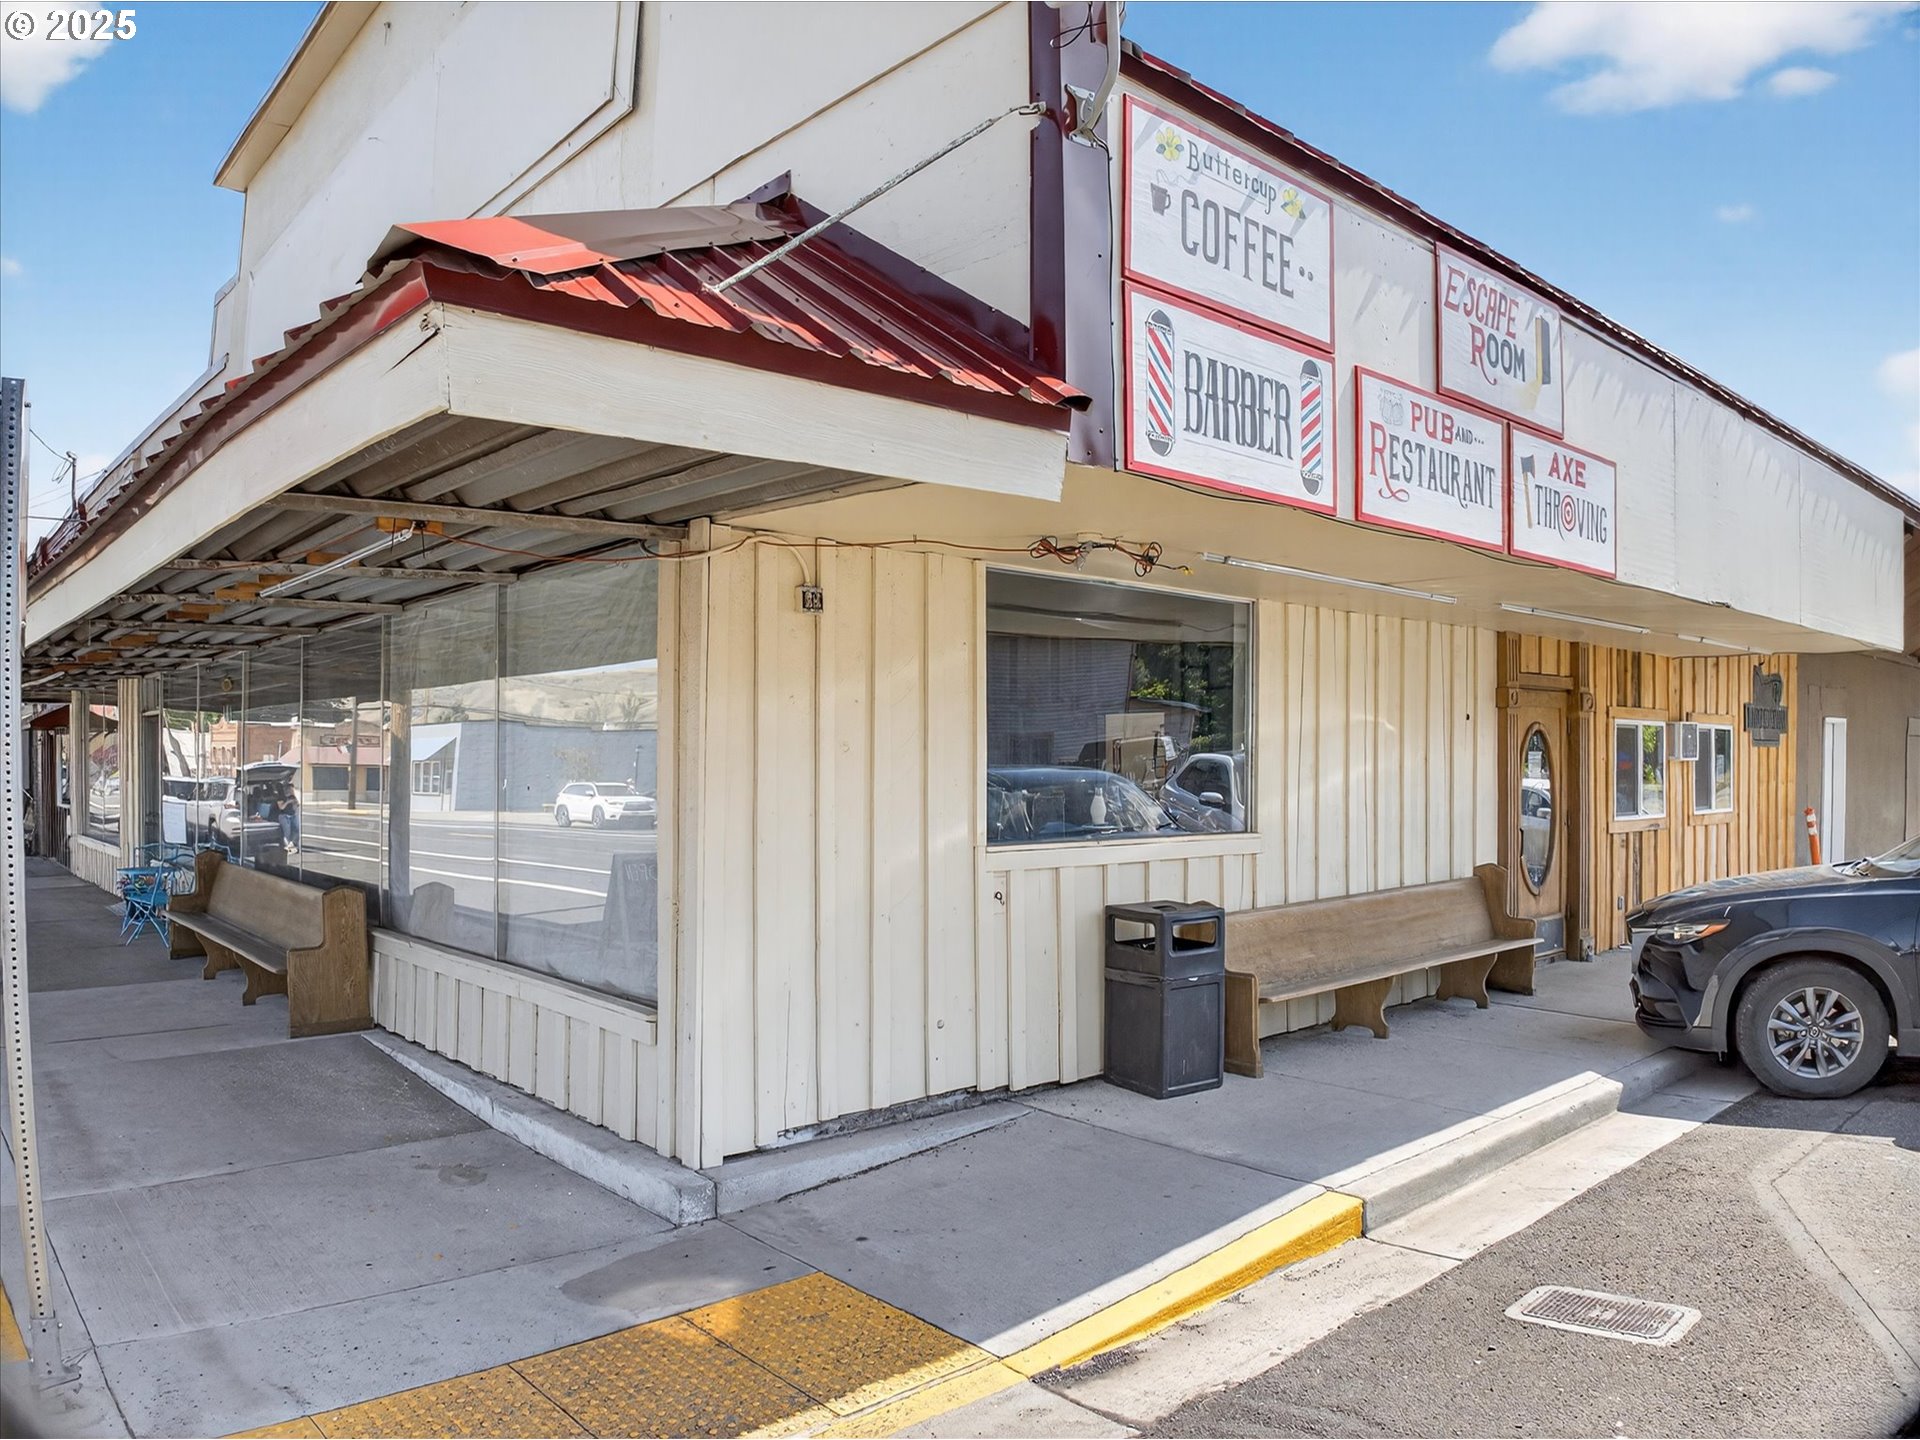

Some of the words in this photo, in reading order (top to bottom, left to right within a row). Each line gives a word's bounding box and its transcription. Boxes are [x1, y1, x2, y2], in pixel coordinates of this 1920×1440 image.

[1186, 140, 1278, 215] Buttercup
[1444, 265, 1520, 340] ESCAPE
[1469, 322, 1526, 386] ROOM
[1183, 350, 1294, 461] BARBER
[1410, 400, 1455, 445] PUB
[1369, 421, 1496, 509] RESTAURANT
[1548, 452, 1586, 489] AXE
